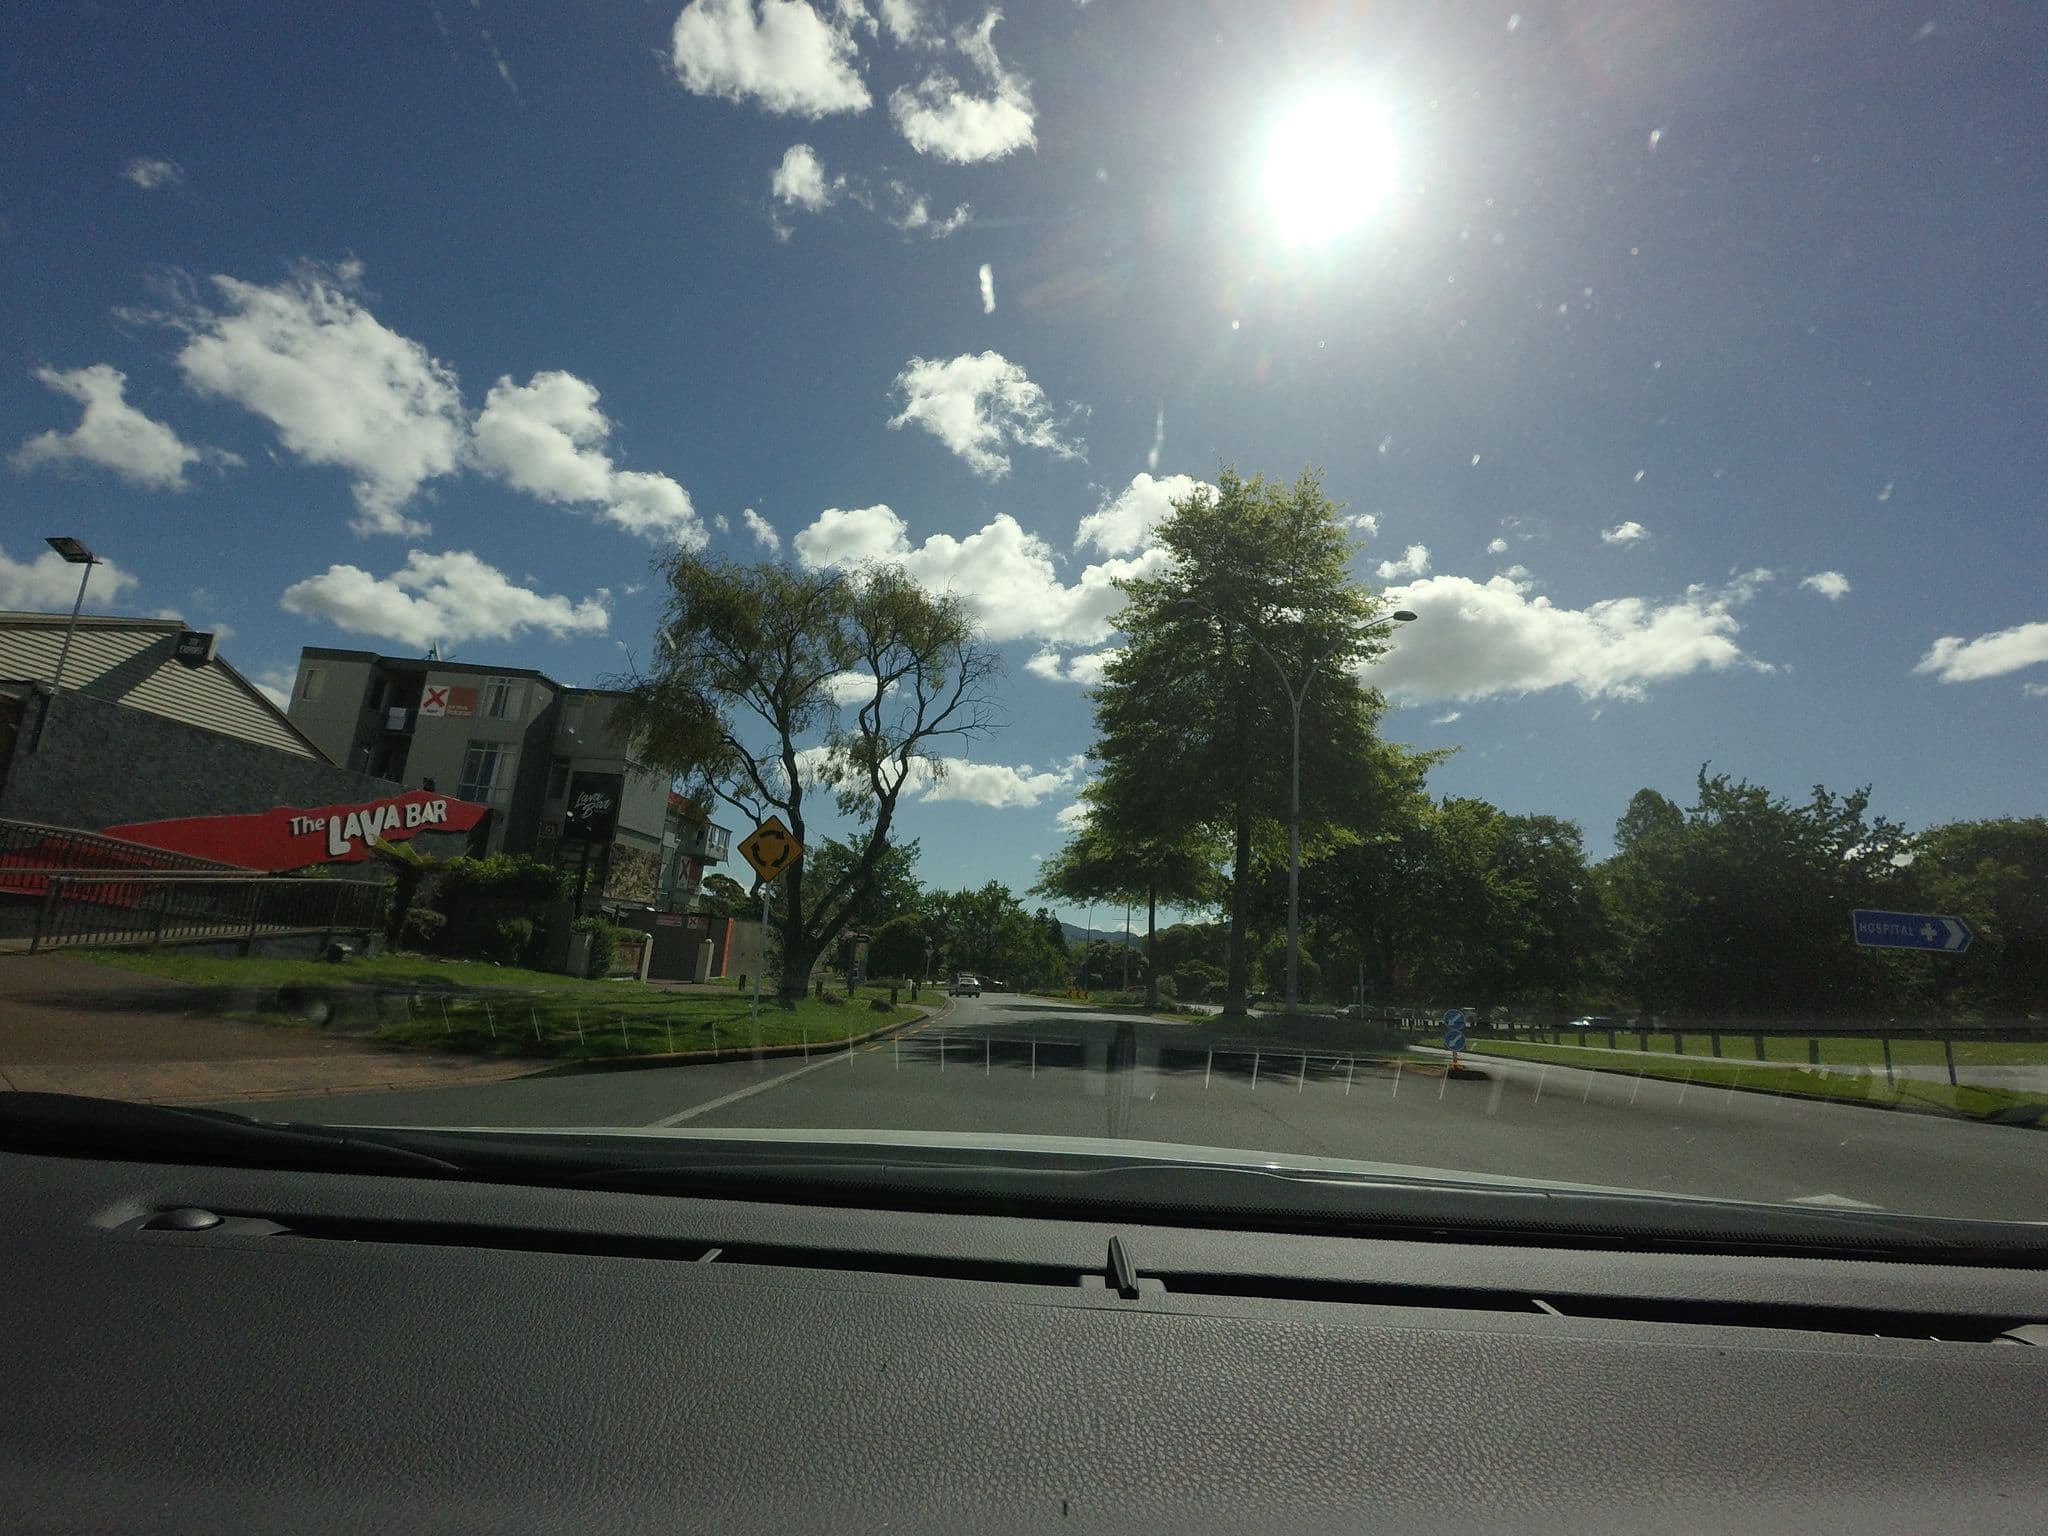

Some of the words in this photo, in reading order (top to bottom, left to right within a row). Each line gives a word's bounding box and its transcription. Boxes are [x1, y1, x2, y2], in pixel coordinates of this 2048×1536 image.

[291, 816, 325, 835] The
[329, 804, 400, 855] LAVA
[406, 800, 447, 828] BAR
[1859, 922, 1914, 937] HOSPITAL
